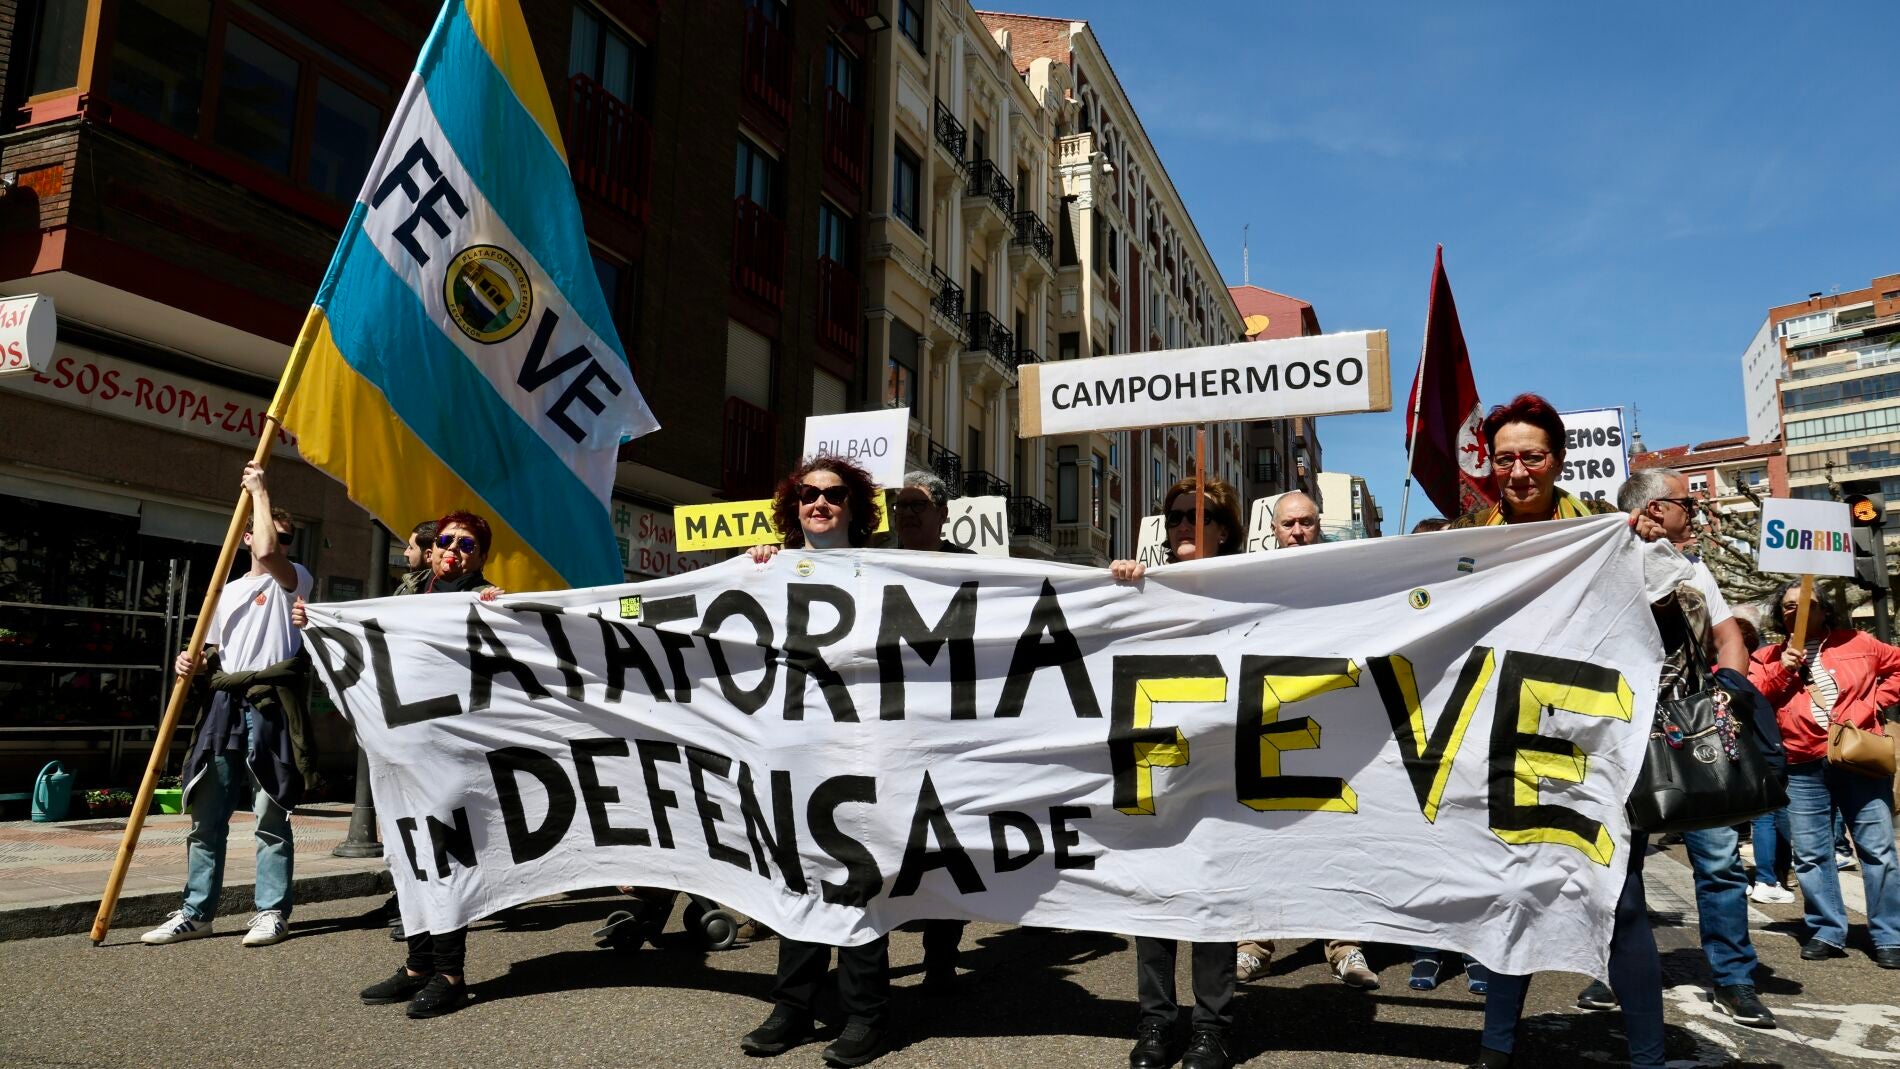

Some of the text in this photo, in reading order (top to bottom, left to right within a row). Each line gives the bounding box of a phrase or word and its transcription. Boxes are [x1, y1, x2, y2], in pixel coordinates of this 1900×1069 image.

[461, 249, 528, 320] PLATAFORMA DEFENSA
[1052, 357, 1364, 410] CAMPOHERMOSO
[1565, 425, 1621, 449] EMOS
[1556, 457, 1615, 481] STRO
[685, 511, 772, 542] MATA
[305, 577, 1103, 738] PLATAFORMA
[486, 738, 987, 908] DEFENSA
[988, 806, 1096, 874] DE
[1108, 646, 1635, 868] FEVE
